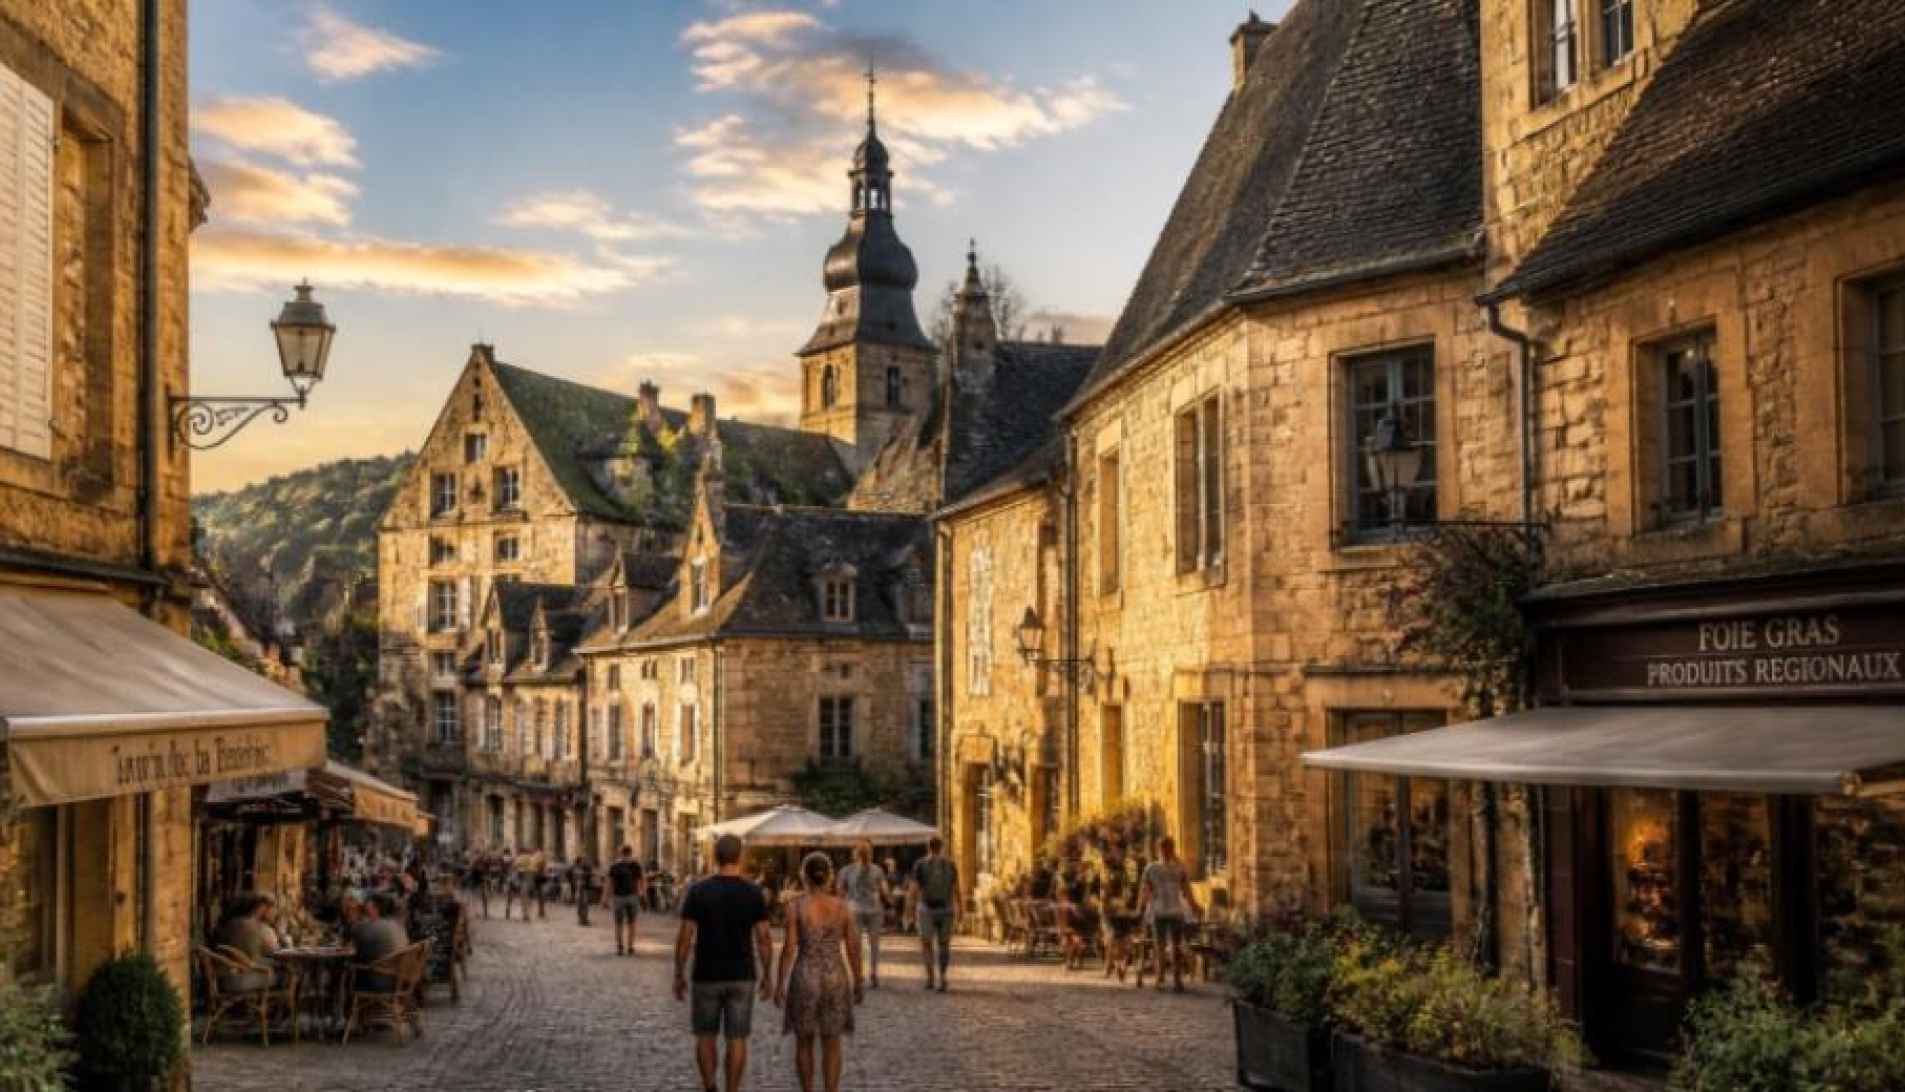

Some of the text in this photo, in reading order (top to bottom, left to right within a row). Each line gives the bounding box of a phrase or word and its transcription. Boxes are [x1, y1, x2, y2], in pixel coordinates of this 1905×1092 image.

[1699, 615, 1841, 651] FOIE GRAS
[1648, 653, 1902, 686] PRODUITS REGIONAUX
